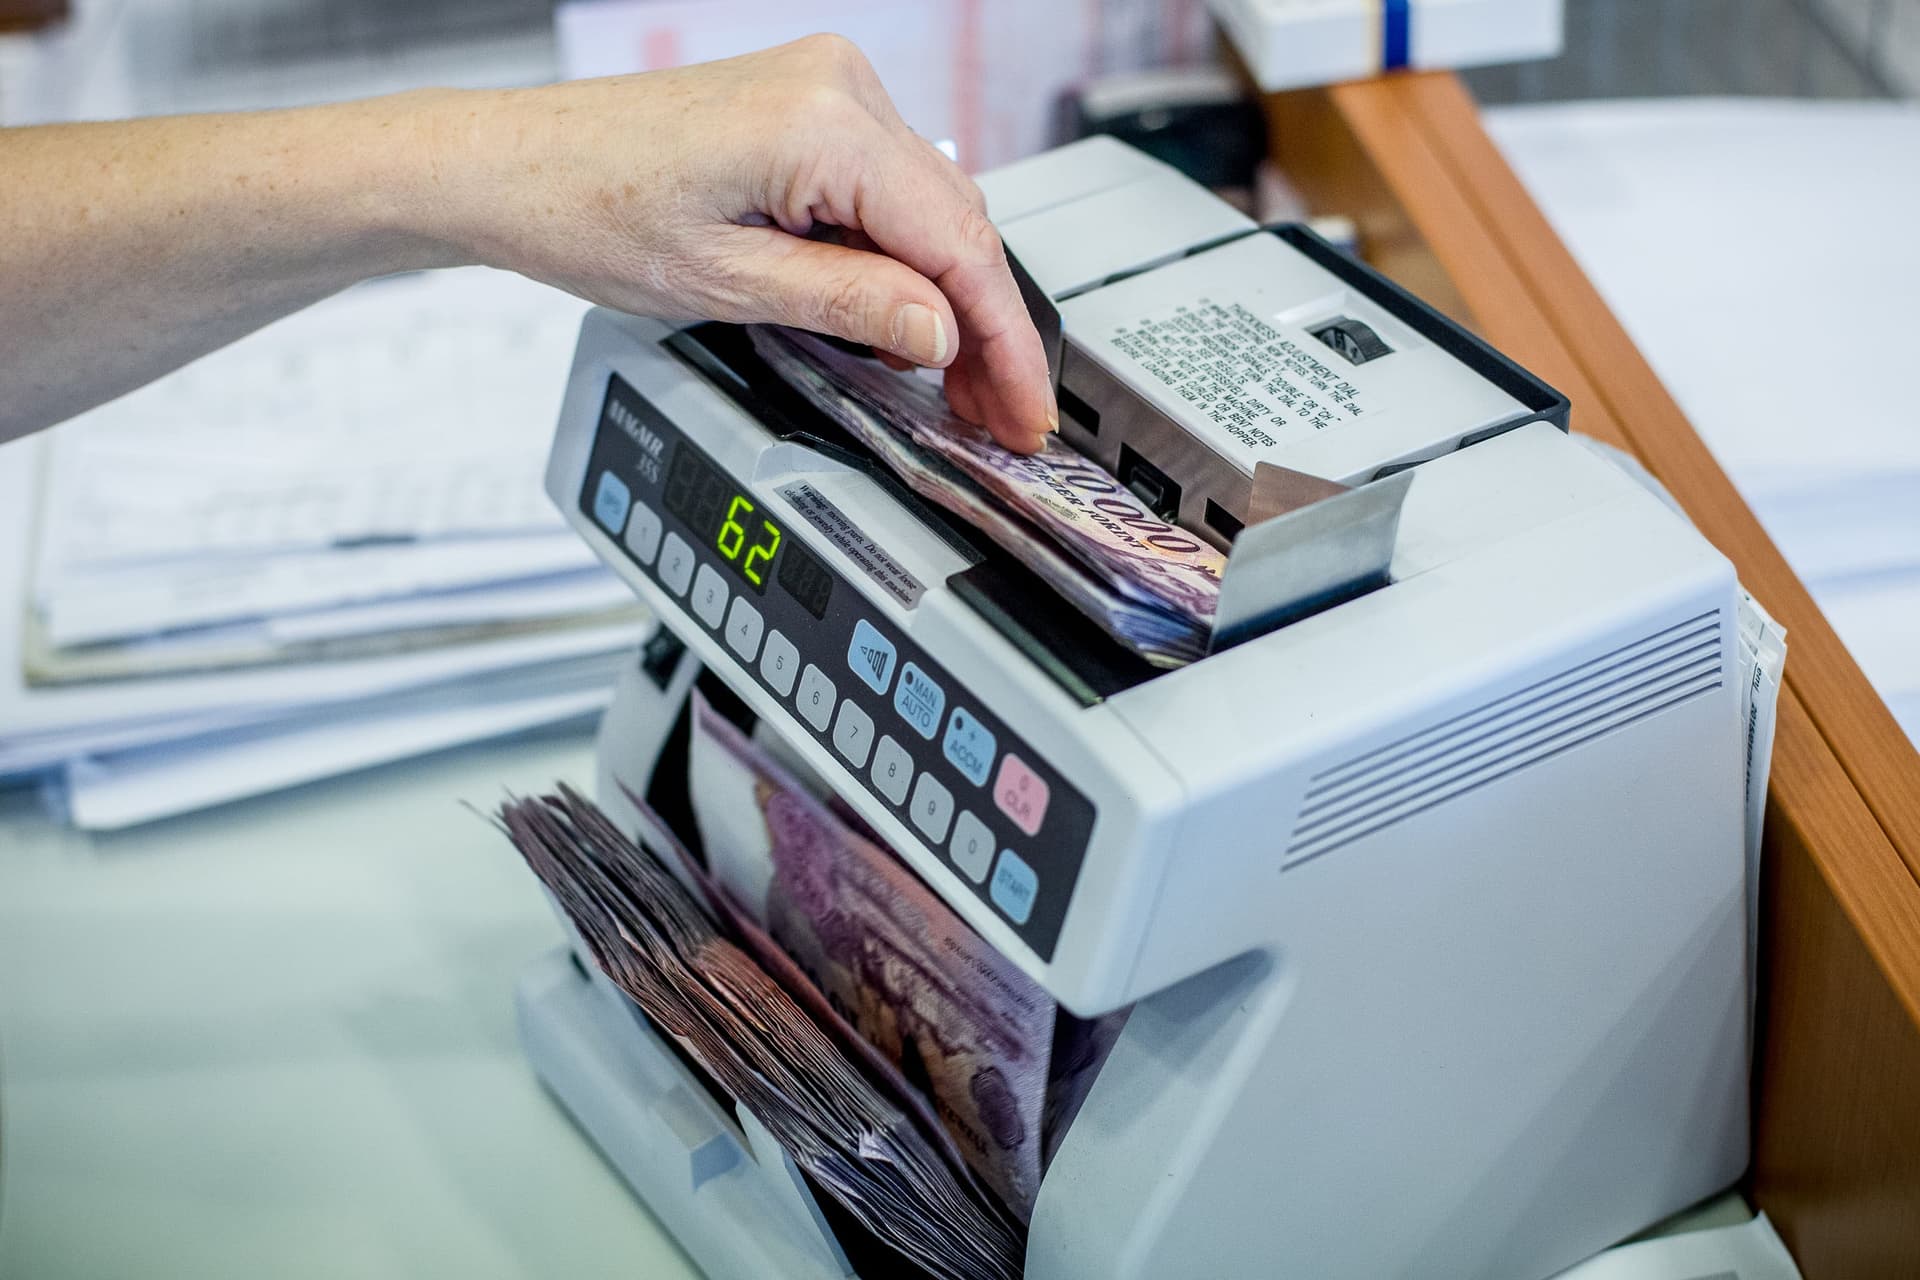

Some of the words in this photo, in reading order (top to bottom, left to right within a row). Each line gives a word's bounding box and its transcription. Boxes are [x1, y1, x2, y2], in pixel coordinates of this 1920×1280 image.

[1178, 335, 1198, 346] AND
[1195, 348, 1215, 359] SEE
[1176, 360, 1199, 374] NOTE
[1206, 382, 1226, 394] THE
[1278, 340, 1340, 382] ADJUSTMENT
[1334, 382, 1360, 399] DIAL
[1176, 348, 1200, 362] LOAD
[1198, 363, 1248, 398] EXCESSIVELY
[1246, 398, 1273, 416] DIRTY
[1270, 416, 1286, 426] OR
[1266, 346, 1283, 356] NEW
[1308, 376, 1330, 390] TURN
[1328, 390, 1347, 403] THE
[1343, 402, 1364, 416] DIAL
[1140, 362, 1176, 385] LOADING
[1174, 384, 1198, 402] THEM
[1196, 402, 1210, 410] IN
[1207, 410, 1226, 423] THE
[1223, 422, 1259, 448] HOPPER.
[1170, 369, 1188, 380] ANY
[1186, 381, 1218, 402] CURLED
[1214, 402, 1232, 412] OR
[1228, 412, 1252, 428] BENT
[1248, 427, 1277, 446] NOTES
[1242, 368, 1264, 382] TURN
[1263, 382, 1281, 395] THE
[1277, 394, 1297, 408] DIAL
[1295, 408, 1310, 416] TO
[1308, 416, 1328, 430] THE
[1302, 398, 1320, 410] OR
[805, 509, 815, 518] or
[809, 514, 835, 533] jewelry
[1079, 508, 1149, 550] FORINT
[717, 495, 781, 586] 62
[826, 511, 850, 530] moving
[864, 543, 877, 554] Do
[873, 553, 887, 563] not
[884, 561, 901, 575] wear
[898, 574, 917, 590] loose
[832, 533, 852, 550] while
[672, 557, 681, 573] 2
[847, 547, 877, 571] operating
[873, 569, 888, 582] this
[706, 588, 714, 604] 3
[740, 624, 749, 636] 4
[776, 655, 784, 671] 5
[812, 690, 821, 705] 6
[913, 678, 937, 707] MAN
[901, 695, 932, 728] AUTO
[849, 725, 858, 739] 7
[888, 762, 896, 778] 8
[928, 800, 936, 816] 9
[967, 839, 978, 855] 0
